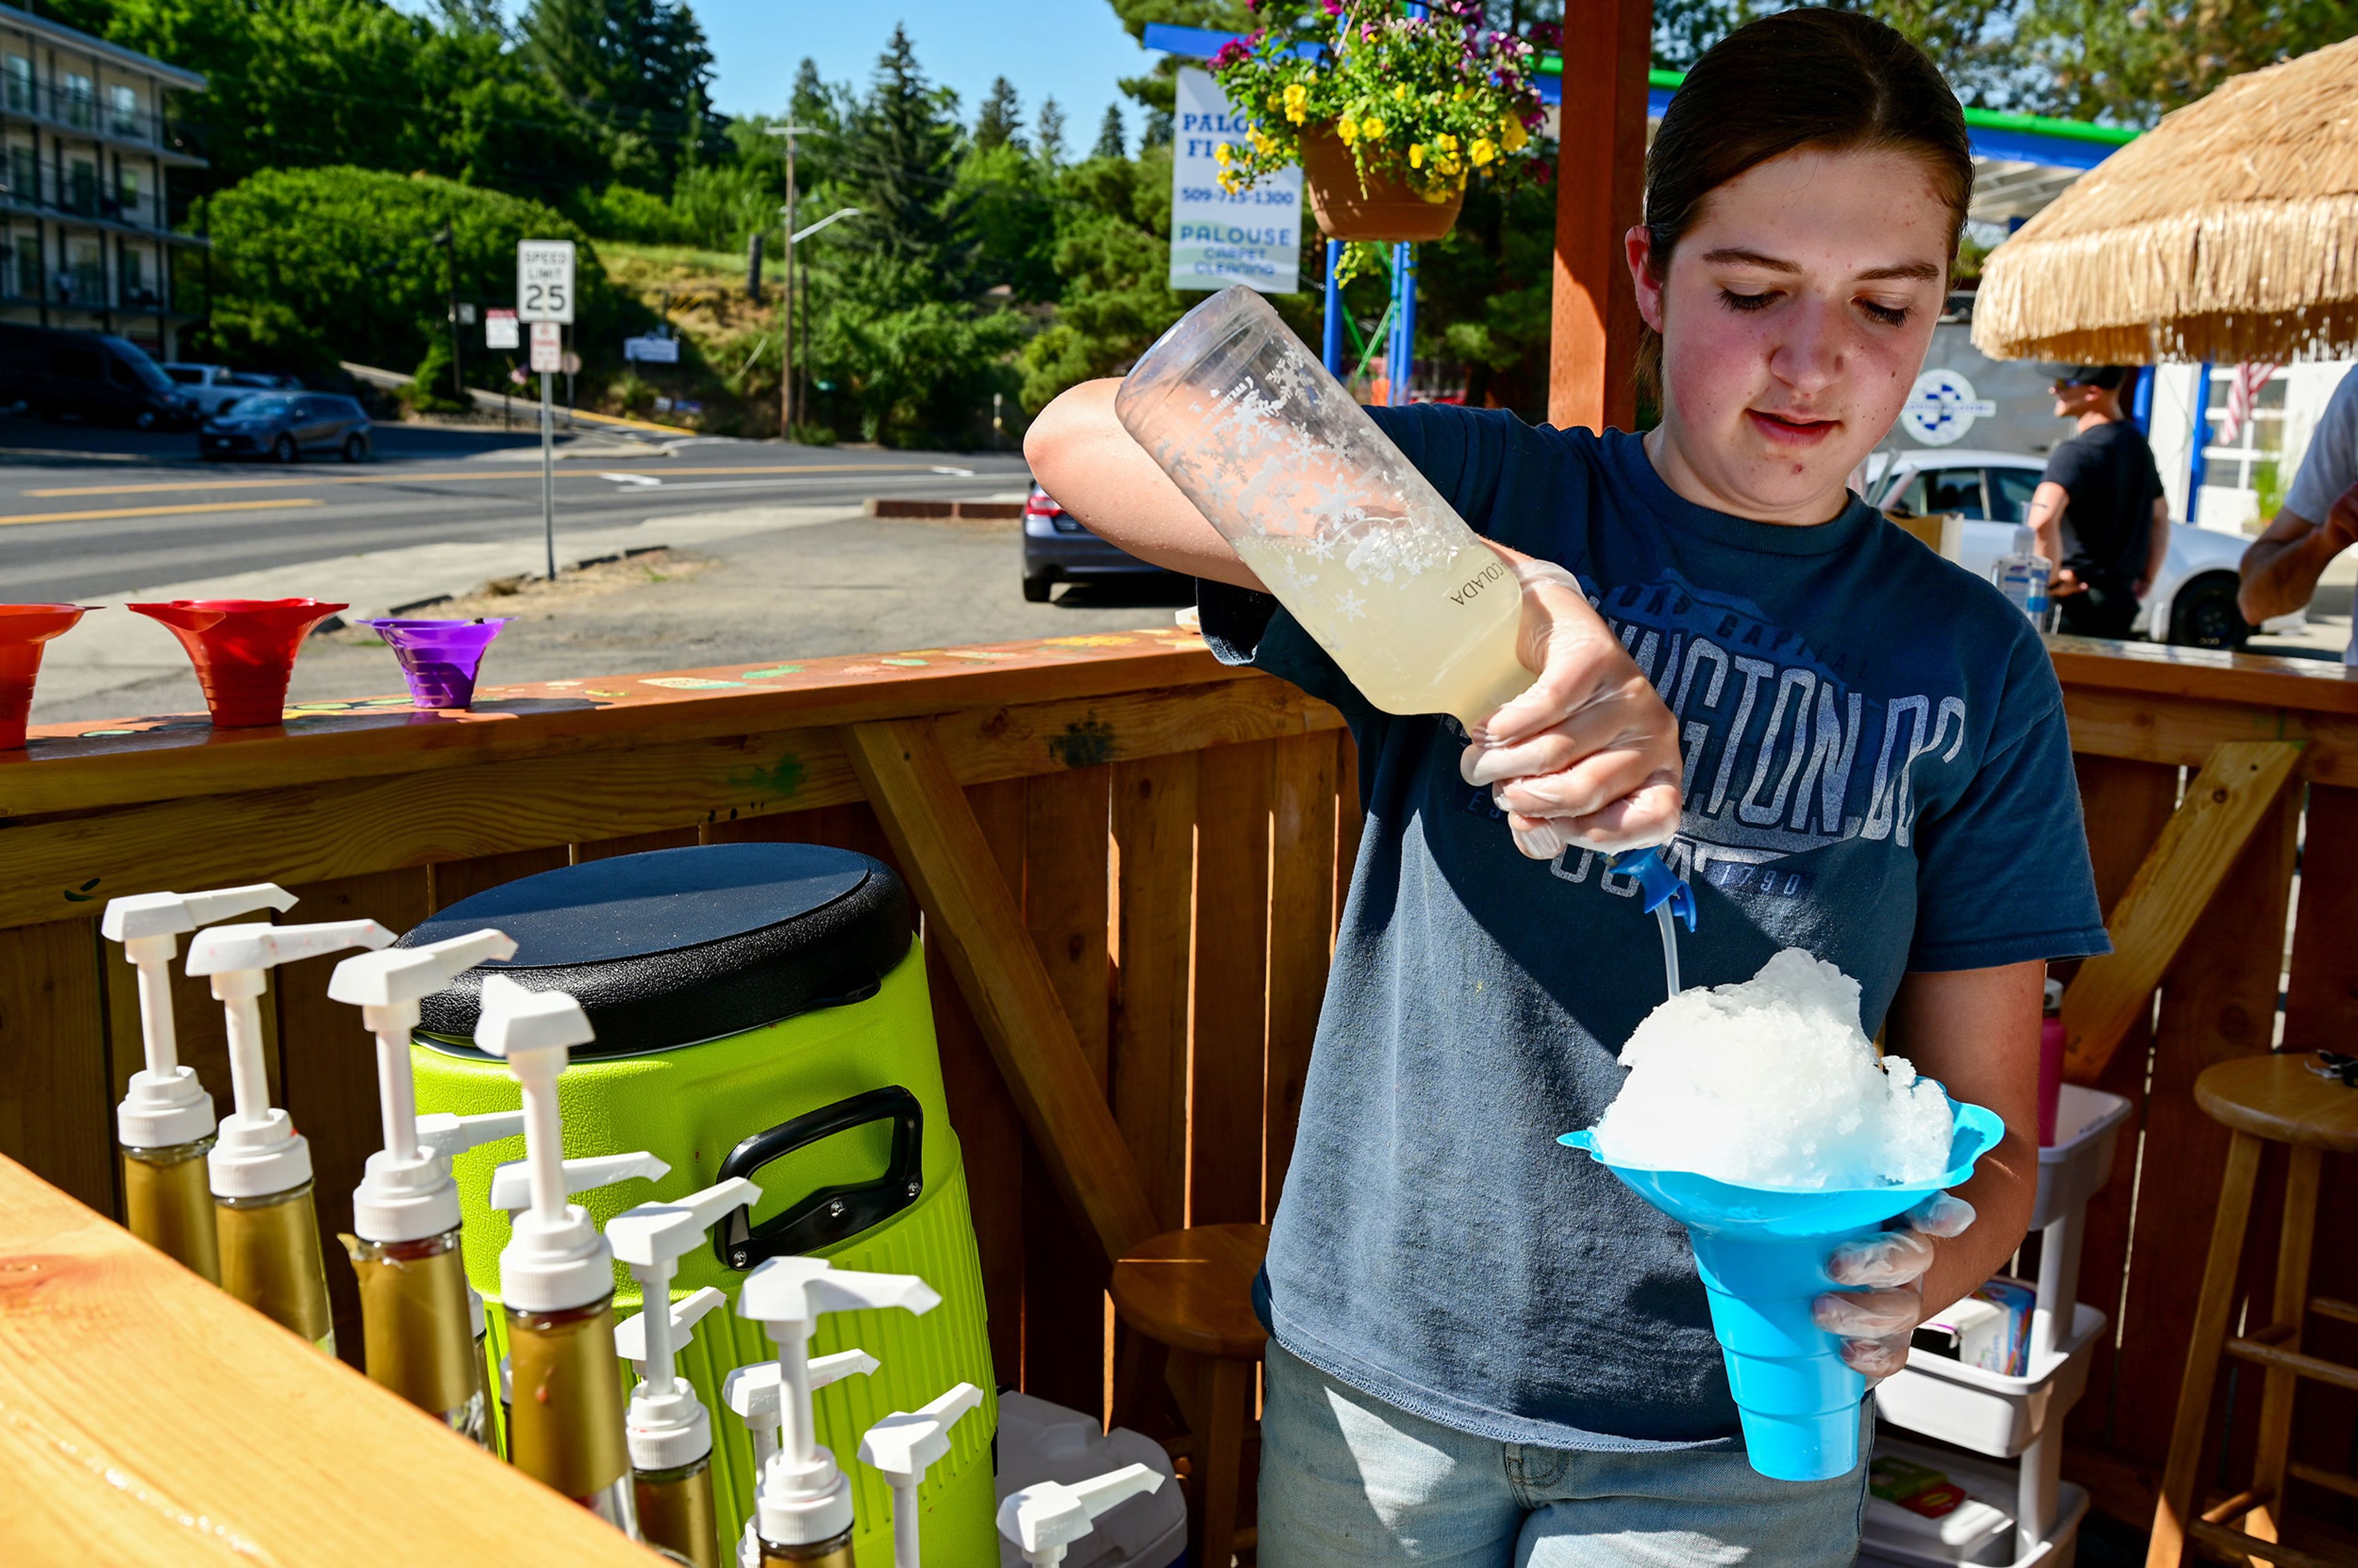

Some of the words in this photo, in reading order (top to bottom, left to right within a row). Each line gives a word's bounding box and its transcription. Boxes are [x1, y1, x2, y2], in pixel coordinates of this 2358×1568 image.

[1183, 114, 1265, 134] PALO
[1180, 225, 1291, 246] PALOUSE
[525, 252, 566, 265] SPEED
[1205, 247, 1266, 260] CARPET
[527, 268, 562, 280] LIMIT
[526, 284, 565, 311] 25
[1450, 562, 1504, 607] COLADA
[1716, 614, 1869, 680] CAPITAL
[1720, 864, 1802, 896] 1790
